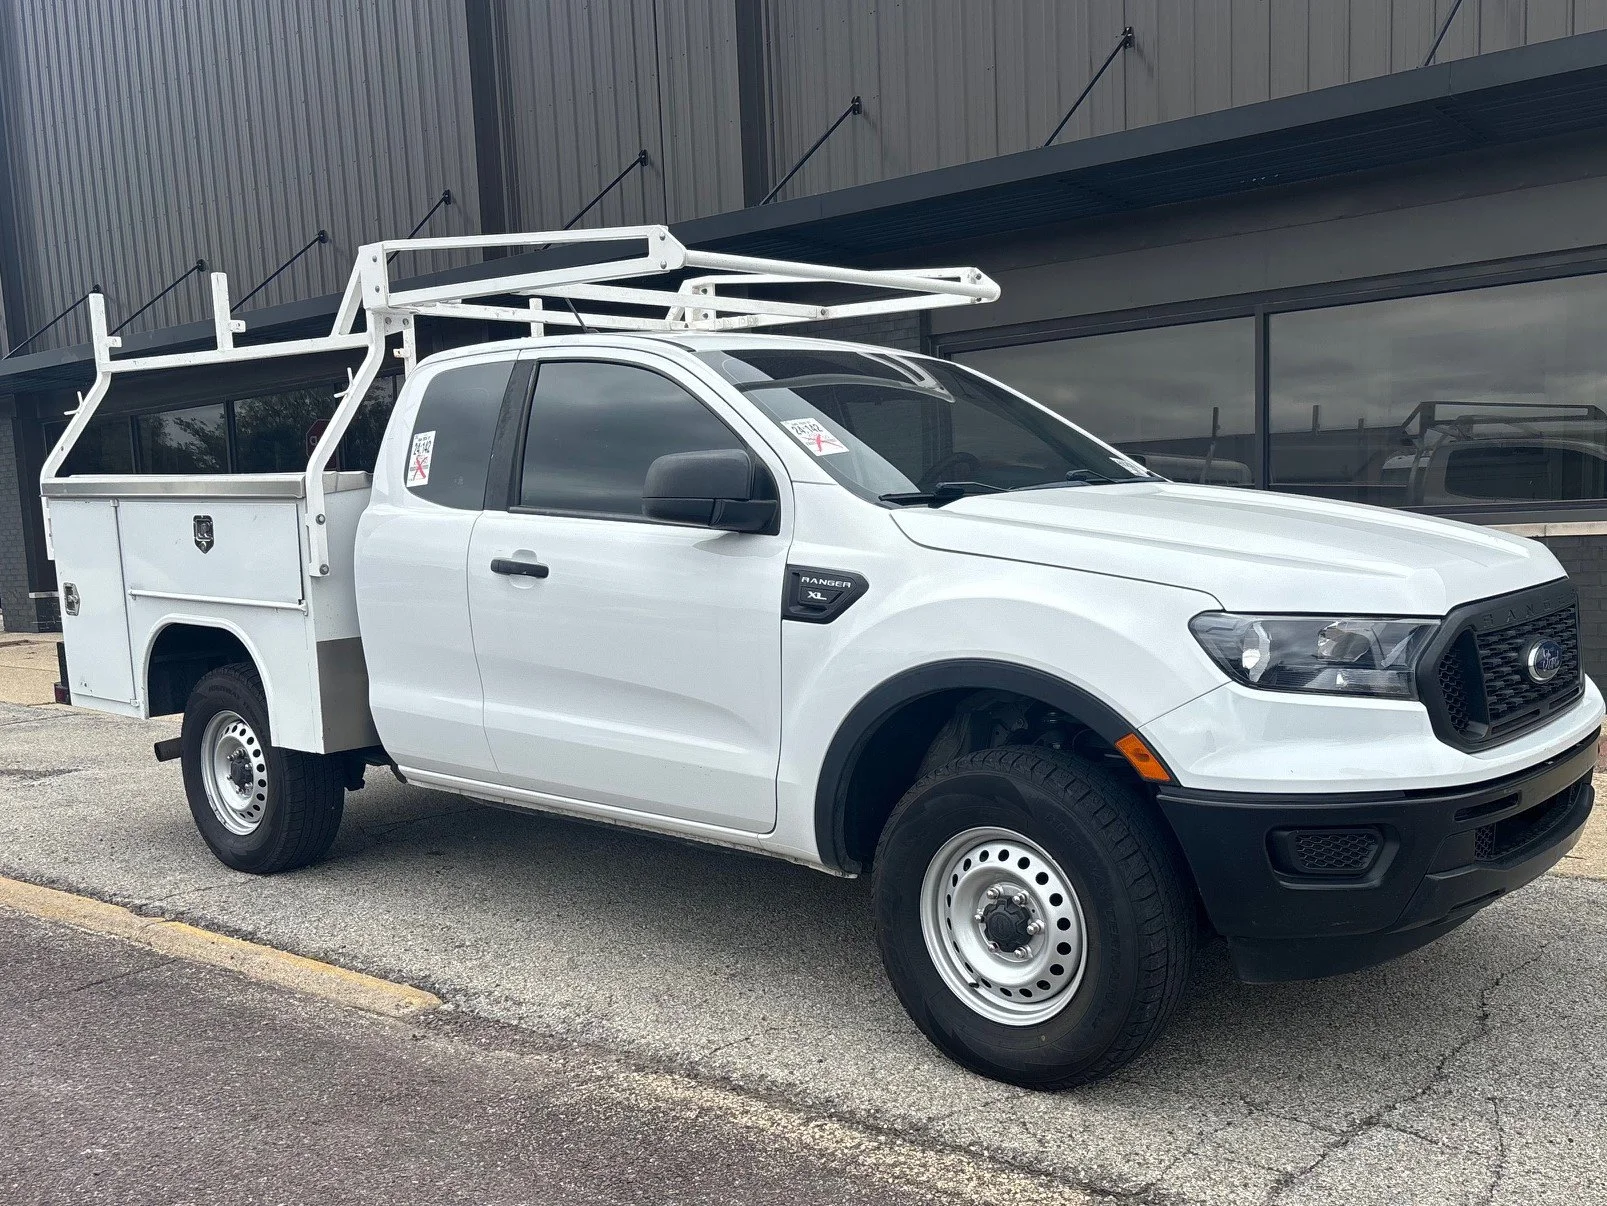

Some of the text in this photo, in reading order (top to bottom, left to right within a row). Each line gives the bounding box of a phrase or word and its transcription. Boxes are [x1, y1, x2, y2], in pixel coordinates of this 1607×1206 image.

[801, 576, 851, 588] RANGER
[807, 591, 827, 601] XL
[1482, 588, 1576, 628] RANGE
